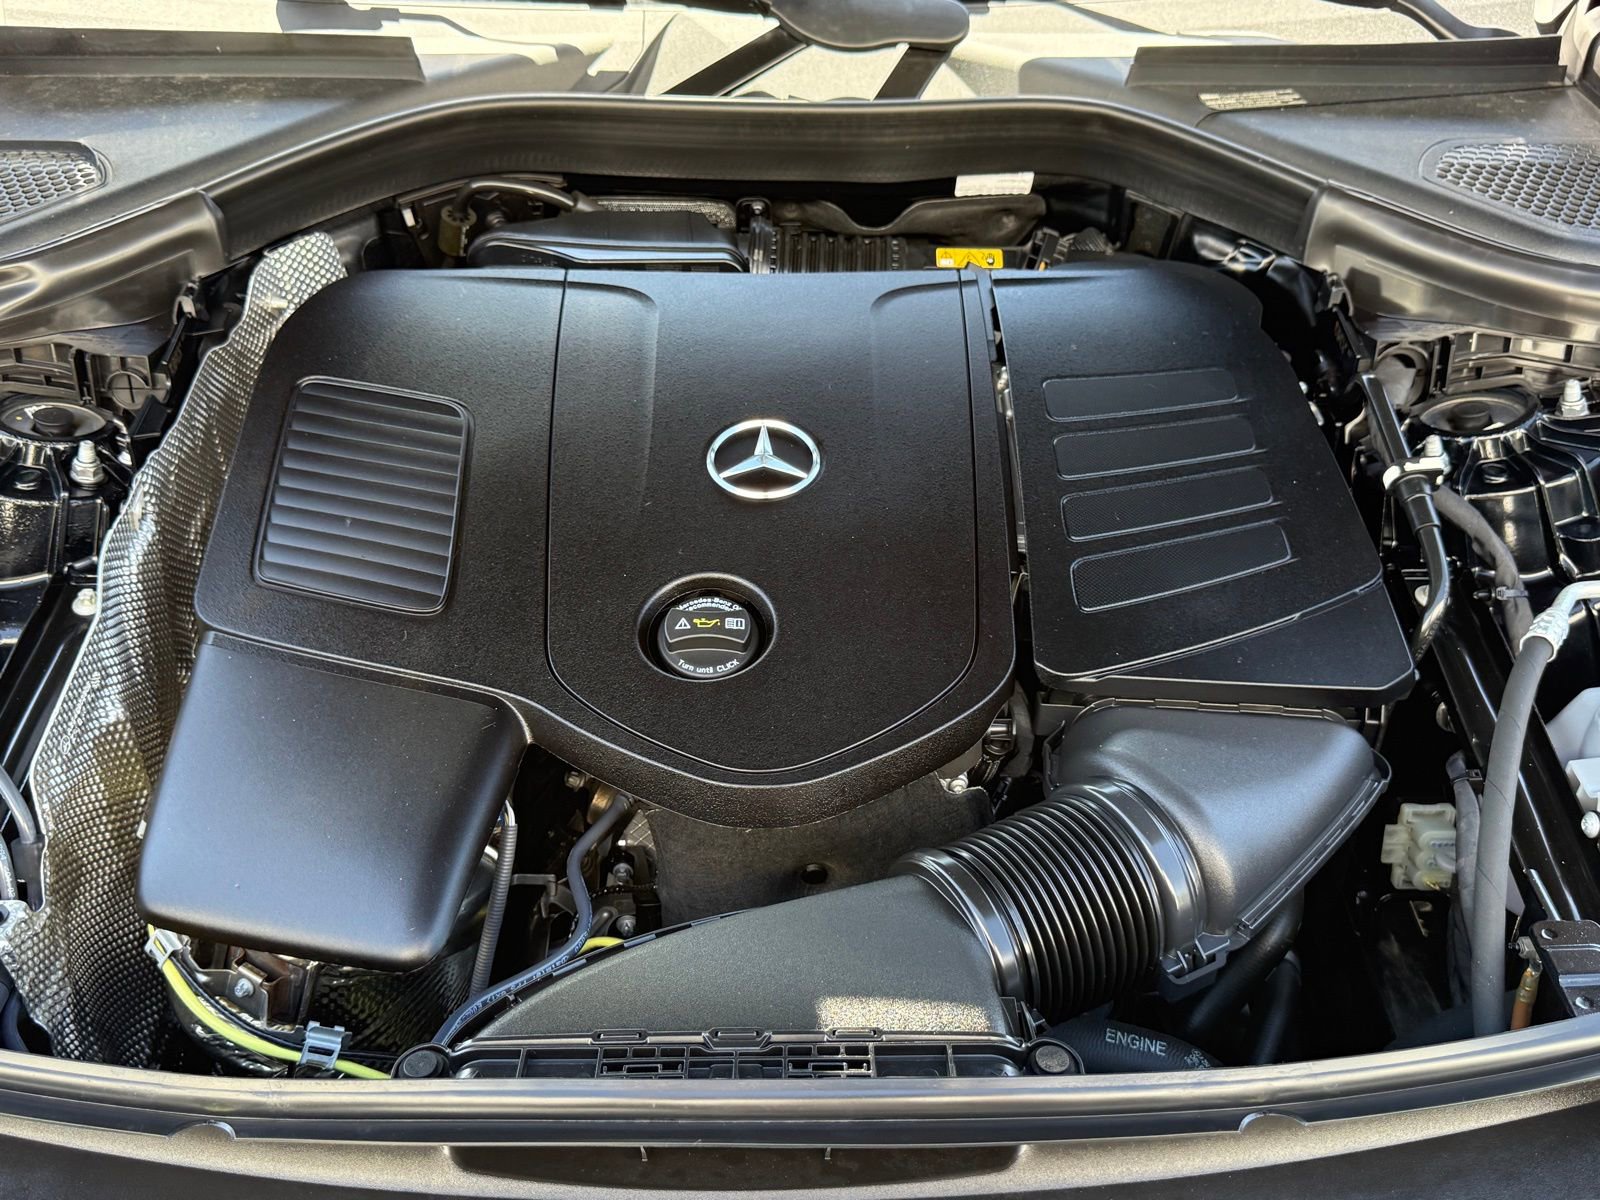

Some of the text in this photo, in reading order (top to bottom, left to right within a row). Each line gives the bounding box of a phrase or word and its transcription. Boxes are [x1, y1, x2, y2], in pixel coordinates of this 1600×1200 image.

[678, 658, 740, 674] Turn until CLICK
[1105, 1028, 1168, 1056] ENGINE
